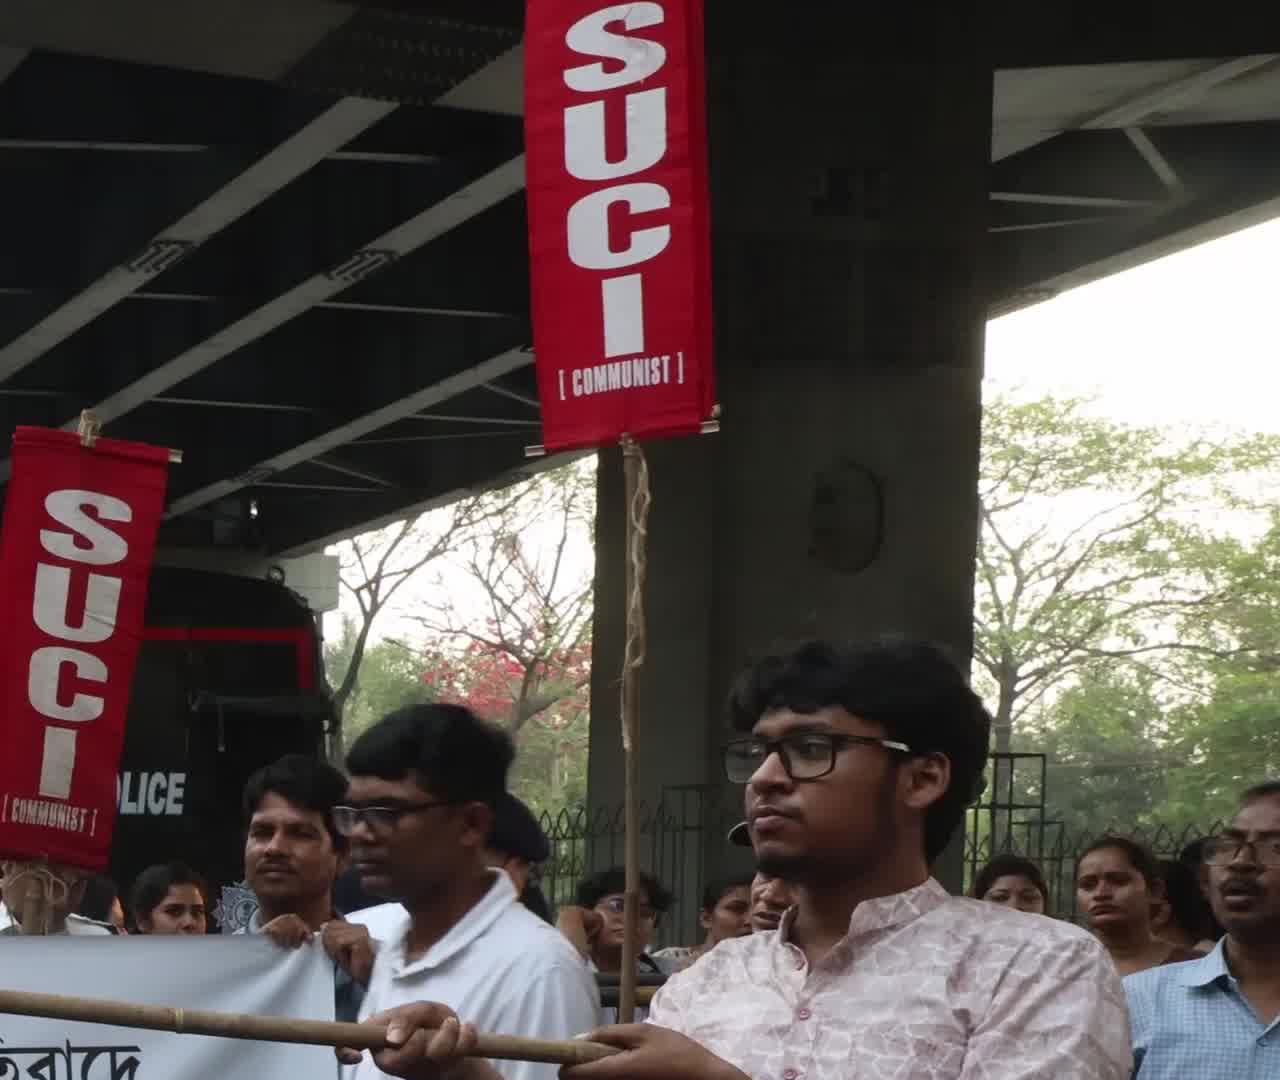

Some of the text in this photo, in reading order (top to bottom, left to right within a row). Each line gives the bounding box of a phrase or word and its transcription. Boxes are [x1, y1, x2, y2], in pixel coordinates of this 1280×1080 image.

[563, 1, 671, 358] SUCI
[572, 354, 670, 397] COMMUNIST
[28, 488, 133, 800] SUCI
[116, 771, 186, 815] LICE
